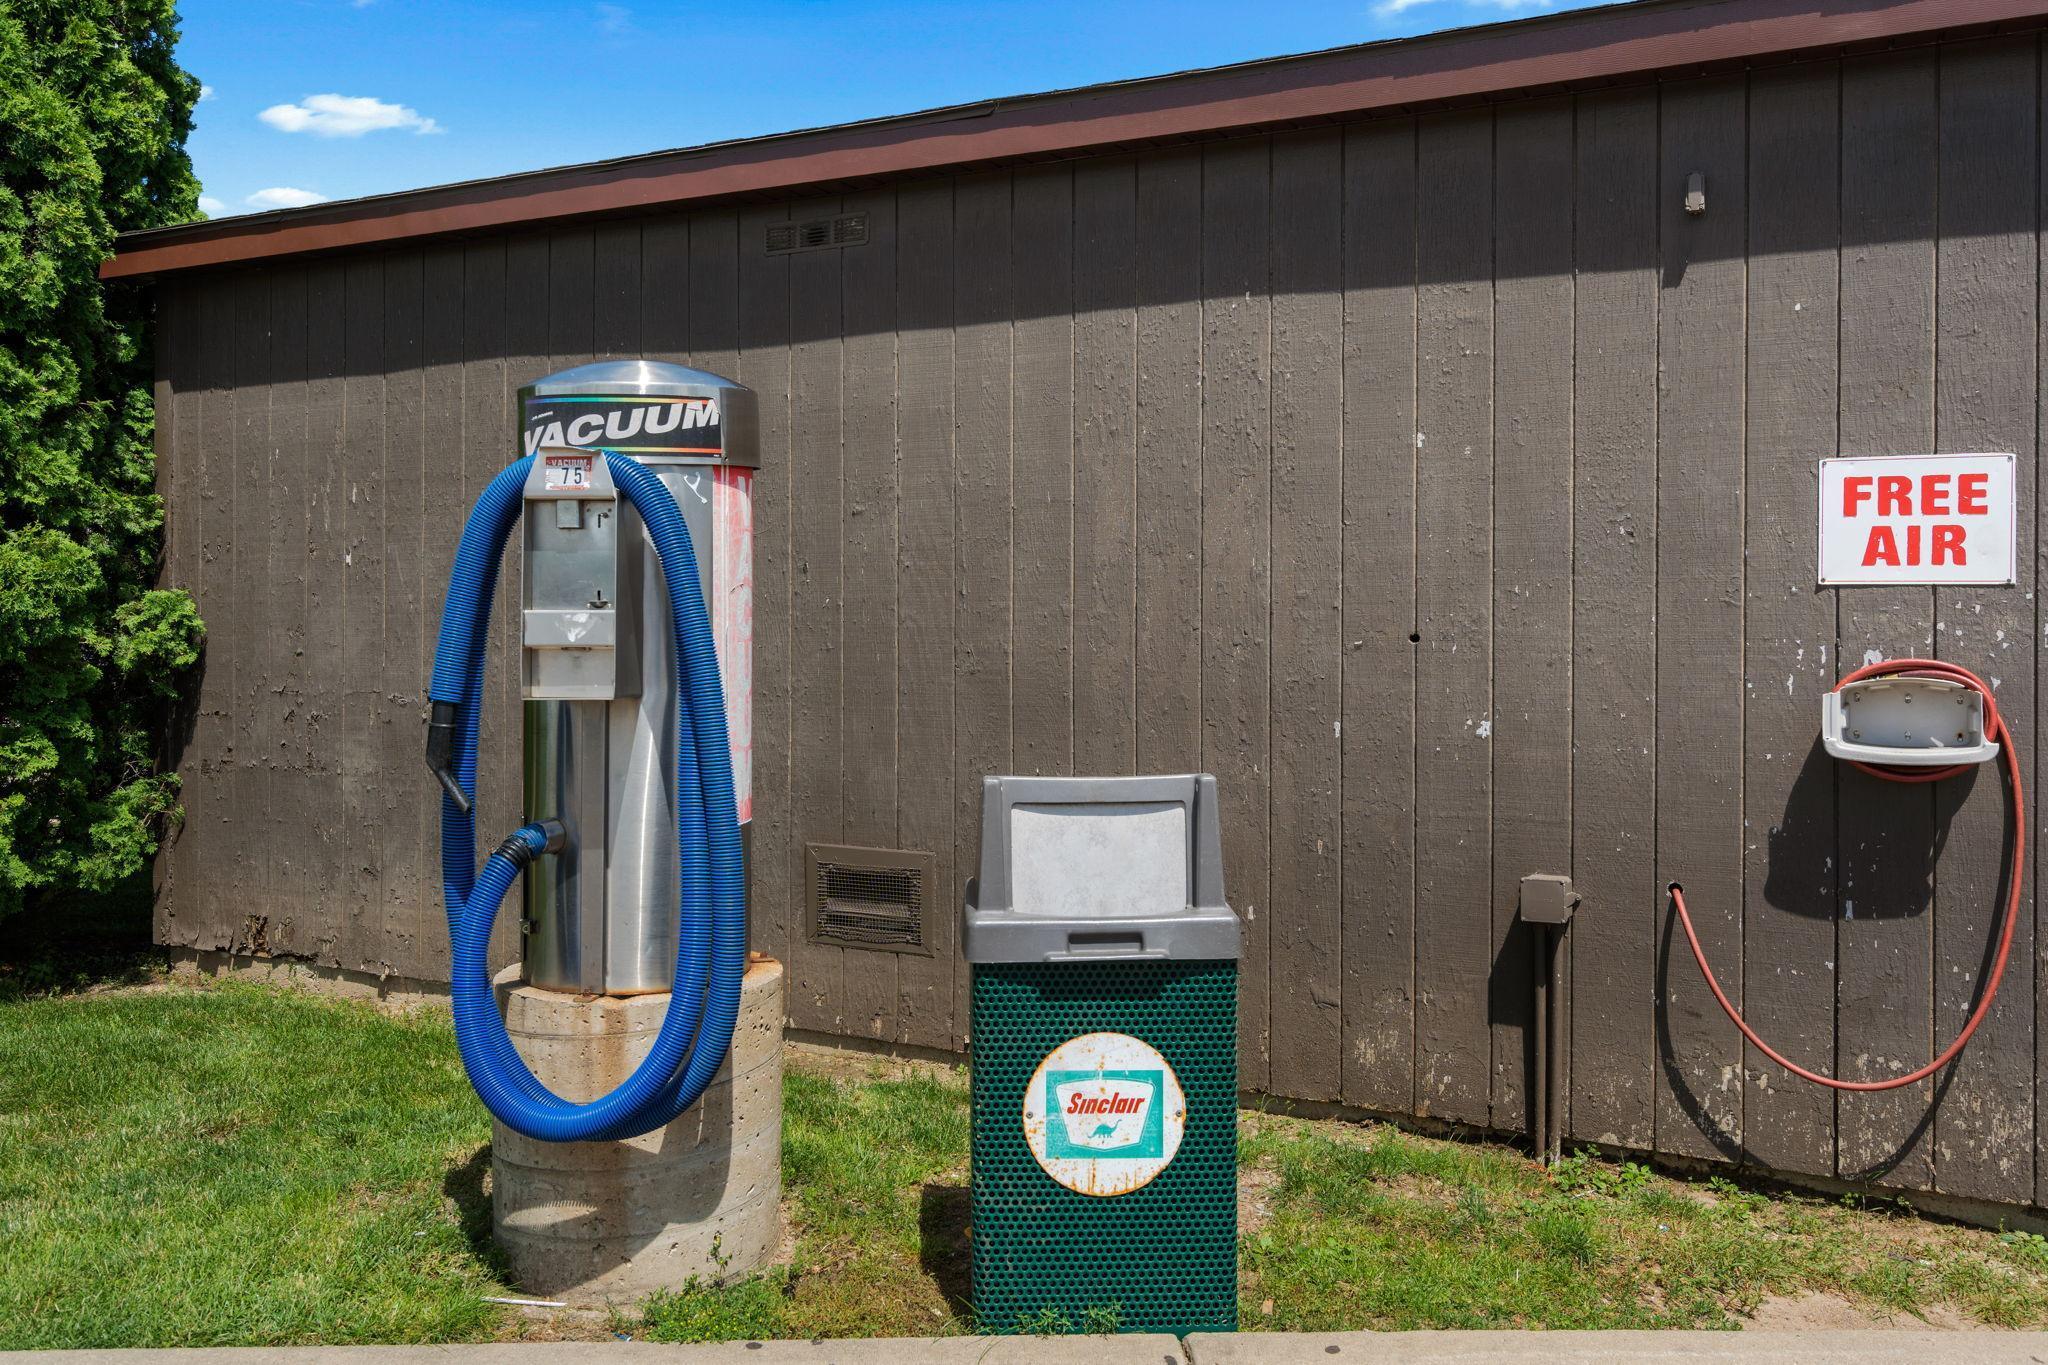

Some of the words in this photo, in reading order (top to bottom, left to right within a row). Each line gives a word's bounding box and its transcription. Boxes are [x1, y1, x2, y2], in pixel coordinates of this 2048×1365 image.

[524, 399, 720, 456] VACUUM
[551, 459, 587, 467] VACUUM
[1843, 473, 1988, 517] FREE
[1861, 525, 1967, 567] AIR
[1067, 1092, 1146, 1115] Sinclair
